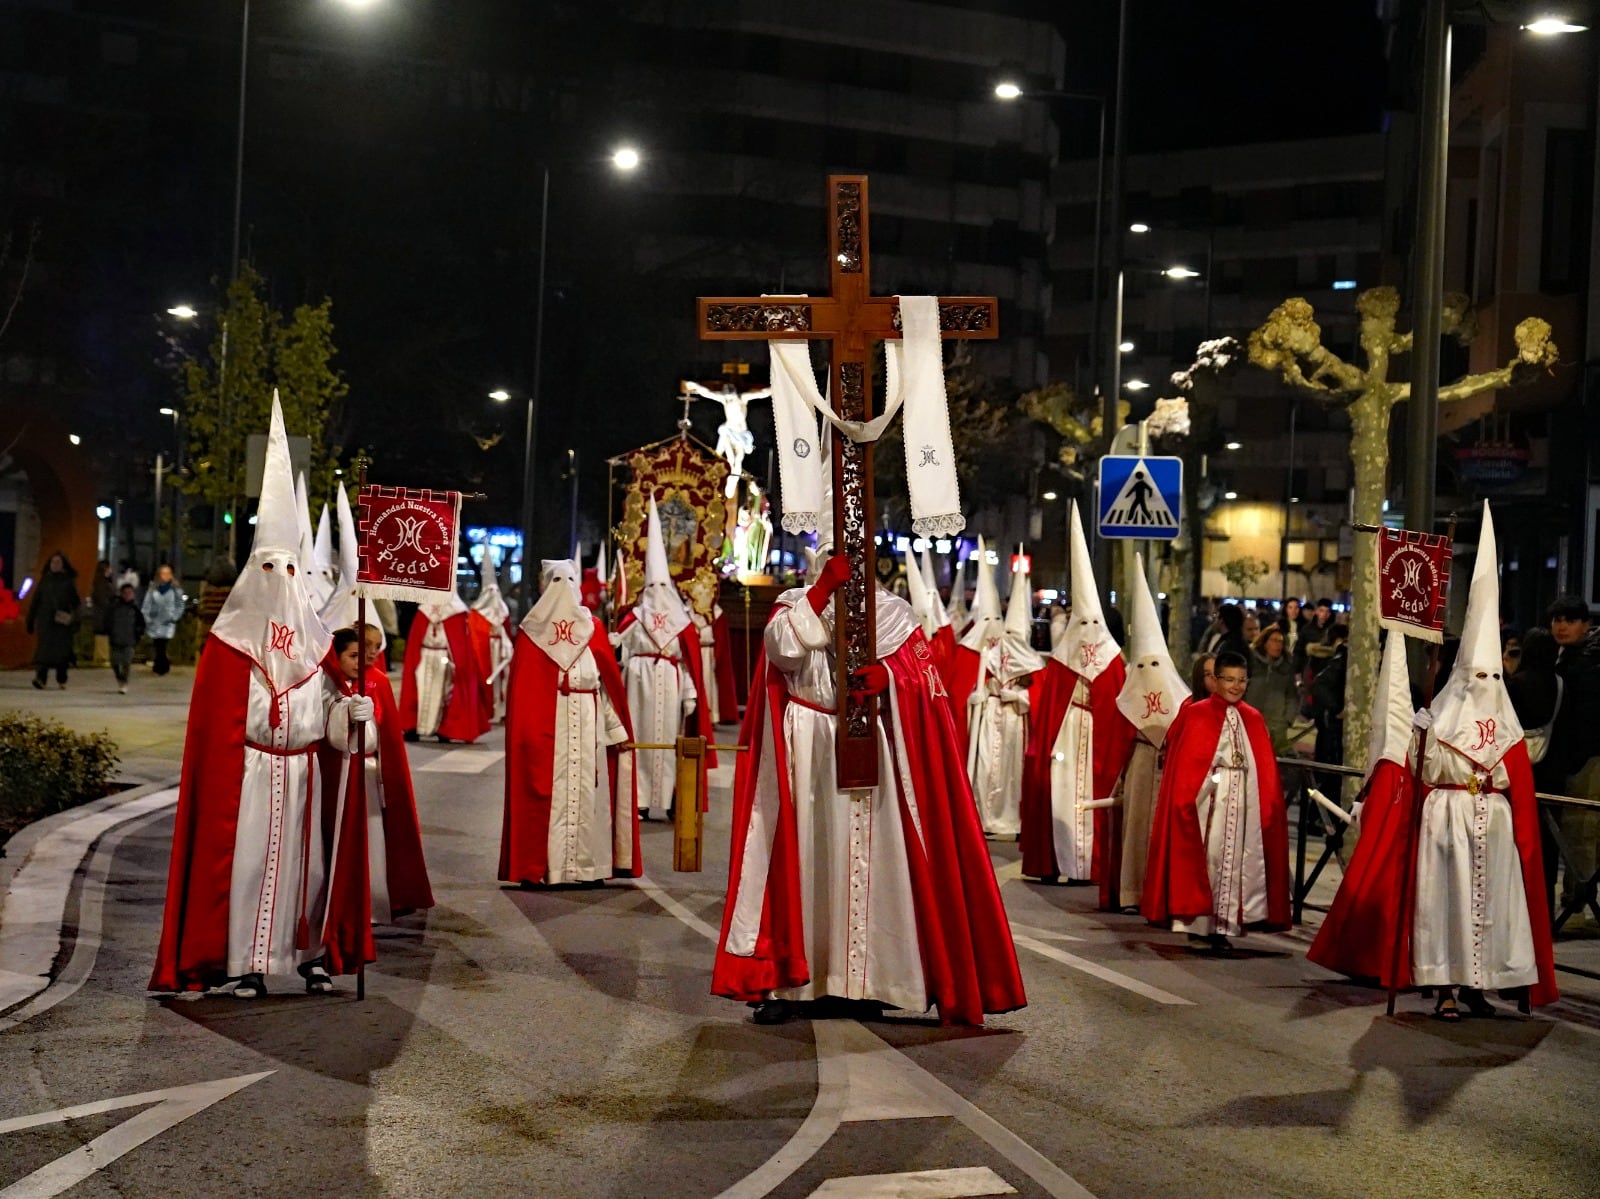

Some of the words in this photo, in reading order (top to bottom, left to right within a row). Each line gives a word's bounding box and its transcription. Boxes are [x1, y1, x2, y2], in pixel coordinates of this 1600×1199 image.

[369, 502, 406, 536] Hermandad
[407, 501, 437, 519] Nuestra
[435, 517, 449, 545] Señora
[377, 549, 440, 574] Piedad
[1382, 544, 1408, 576] Hermandad
[1390, 587, 1430, 613] Piedad
